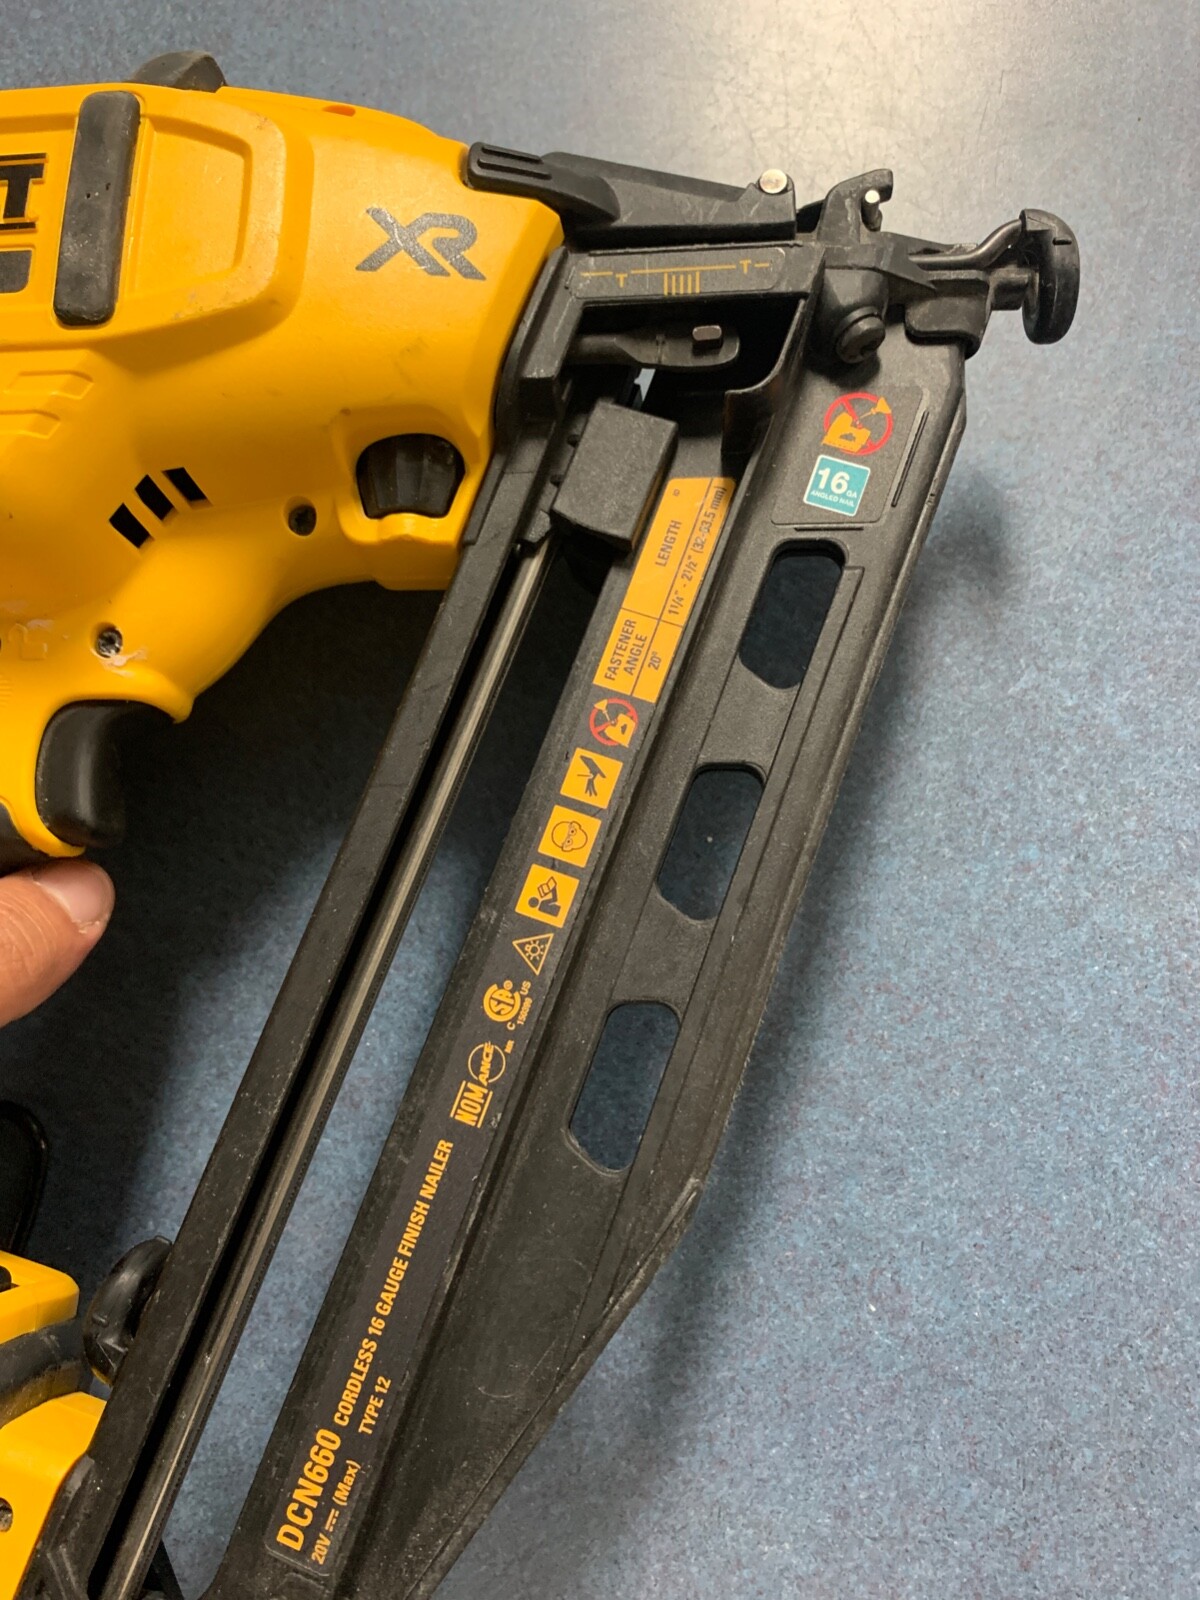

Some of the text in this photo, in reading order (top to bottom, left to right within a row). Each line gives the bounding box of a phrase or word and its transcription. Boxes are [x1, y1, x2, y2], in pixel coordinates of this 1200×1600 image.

[355, 207, 486, 280] XR
[710, 485, 727, 510] mm)
[810, 489, 855, 508] ANGLED NAIL
[818, 467, 850, 495] 16
[655, 519, 682, 567] LENGTH
[604, 619, 637, 681] FASTENER
[623, 633, 648, 676] ANGLE
[519, 980, 532, 996] US
[478, 1040, 496, 1087] ANCE
[454, 1081, 490, 1127] NOM
[276, 1138, 454, 1552] DCN660 CORDLESS 16 GAUGE FINISH NAILER
[358, 1375, 391, 1435] TYPE 12
[311, 1459, 362, 1566] 20V (Max)
